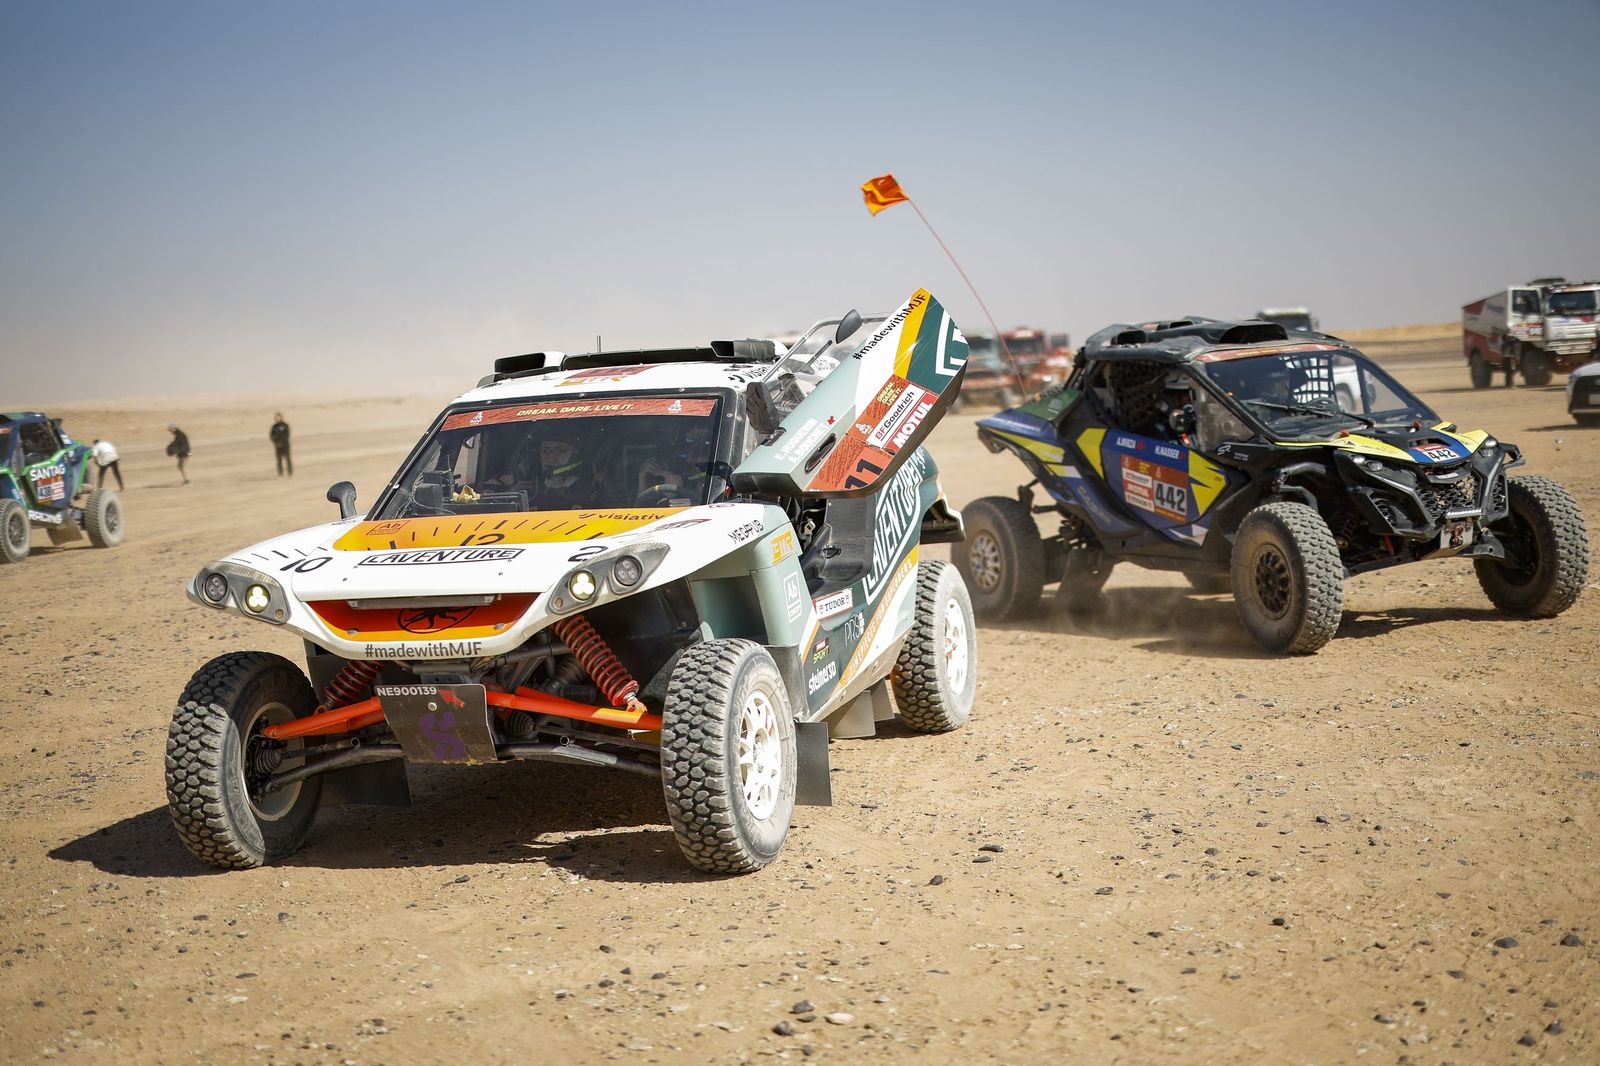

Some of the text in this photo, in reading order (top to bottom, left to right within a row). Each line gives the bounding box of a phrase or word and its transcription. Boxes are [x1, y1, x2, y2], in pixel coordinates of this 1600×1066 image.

[852, 294, 926, 360] #madewithMJF
[516, 408, 558, 416] DREAM.
[875, 391, 915, 440] BFGoodrich
[892, 402, 934, 448] MOTUL
[1428, 450, 1456, 460] 442
[30, 464, 65, 482] SANTAG
[844, 458, 884, 490] 11
[1156, 483, 1185, 512] 442
[368, 550, 515, 563] LAVENTURE
[568, 546, 608, 562] 2
[280, 557, 332, 572] 10
[825, 597, 845, 612] TUDOR
[364, 642, 482, 658] #madewithMJF
[377, 686, 437, 697] NE900139
